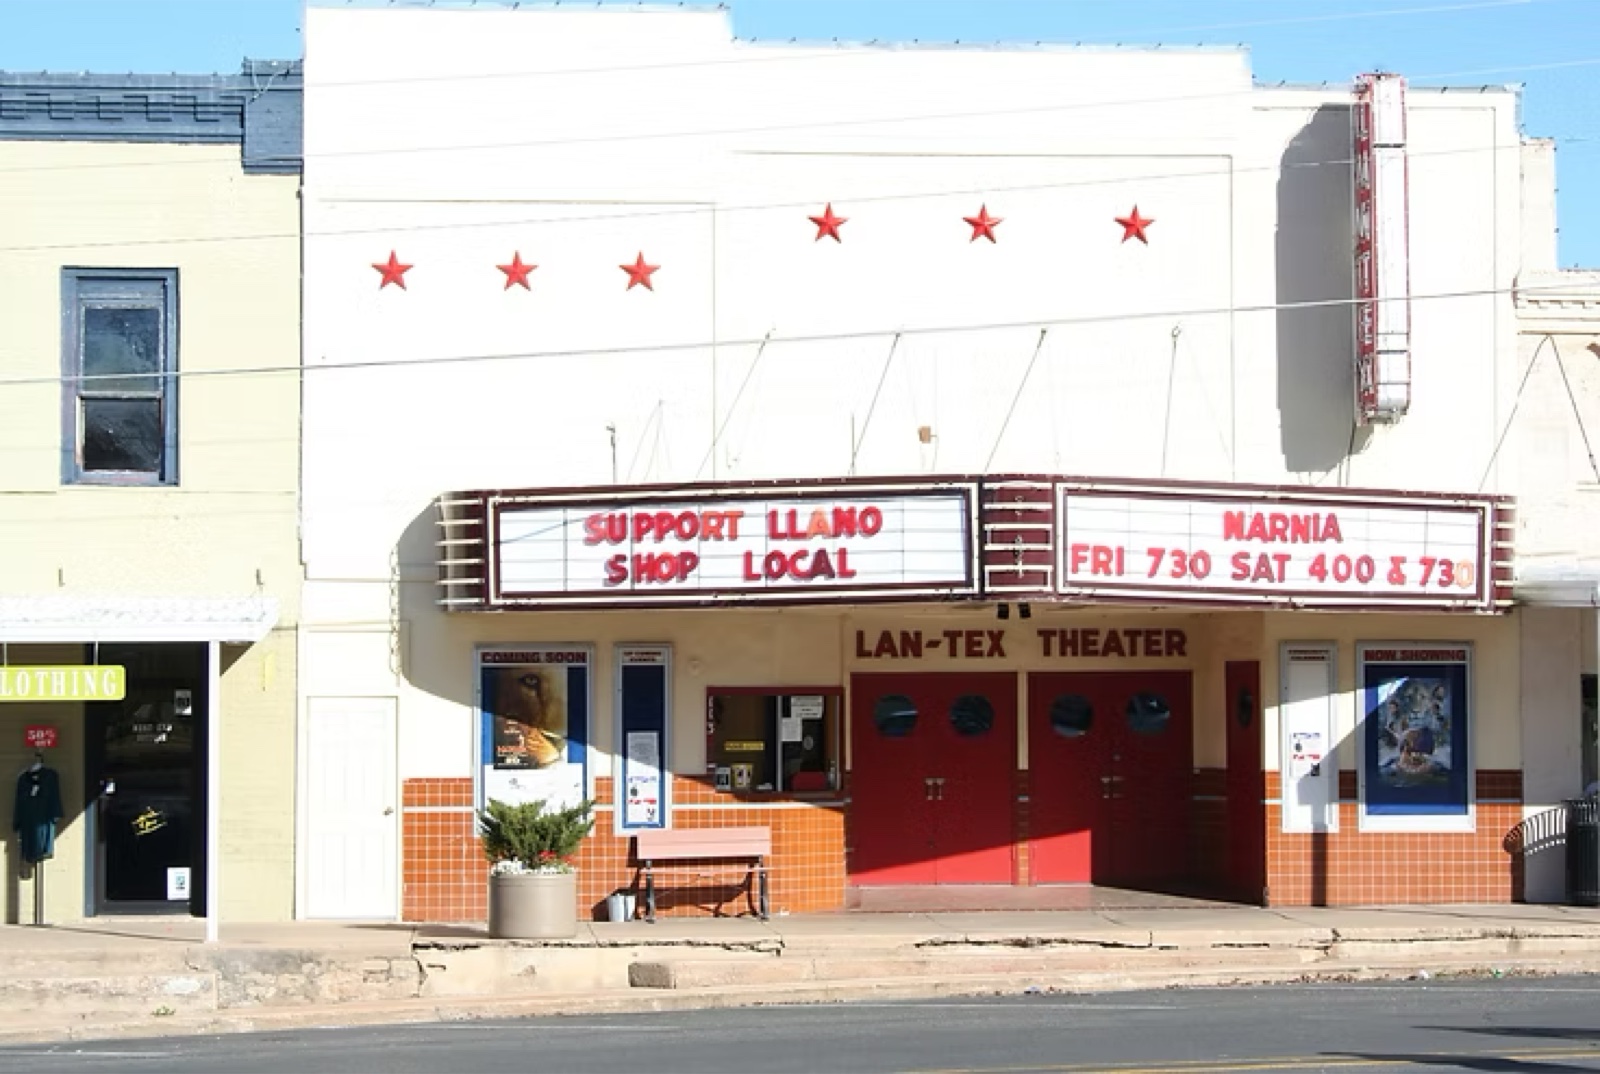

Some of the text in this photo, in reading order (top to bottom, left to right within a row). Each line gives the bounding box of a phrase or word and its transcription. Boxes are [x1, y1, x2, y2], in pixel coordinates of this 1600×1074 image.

[584, 504, 883, 545] SUPPORT LLANO
[1223, 511, 1341, 543] NARNIA
[604, 546, 857, 585] SHOP LOCAL
[1070, 543, 1475, 589] FRI 730 SAT 400 & 730
[481, 651, 588, 664] COMING SOON
[855, 627, 1189, 659] LAN-TEX THEATER
[1364, 650, 1467, 662] NOW SHOWING
